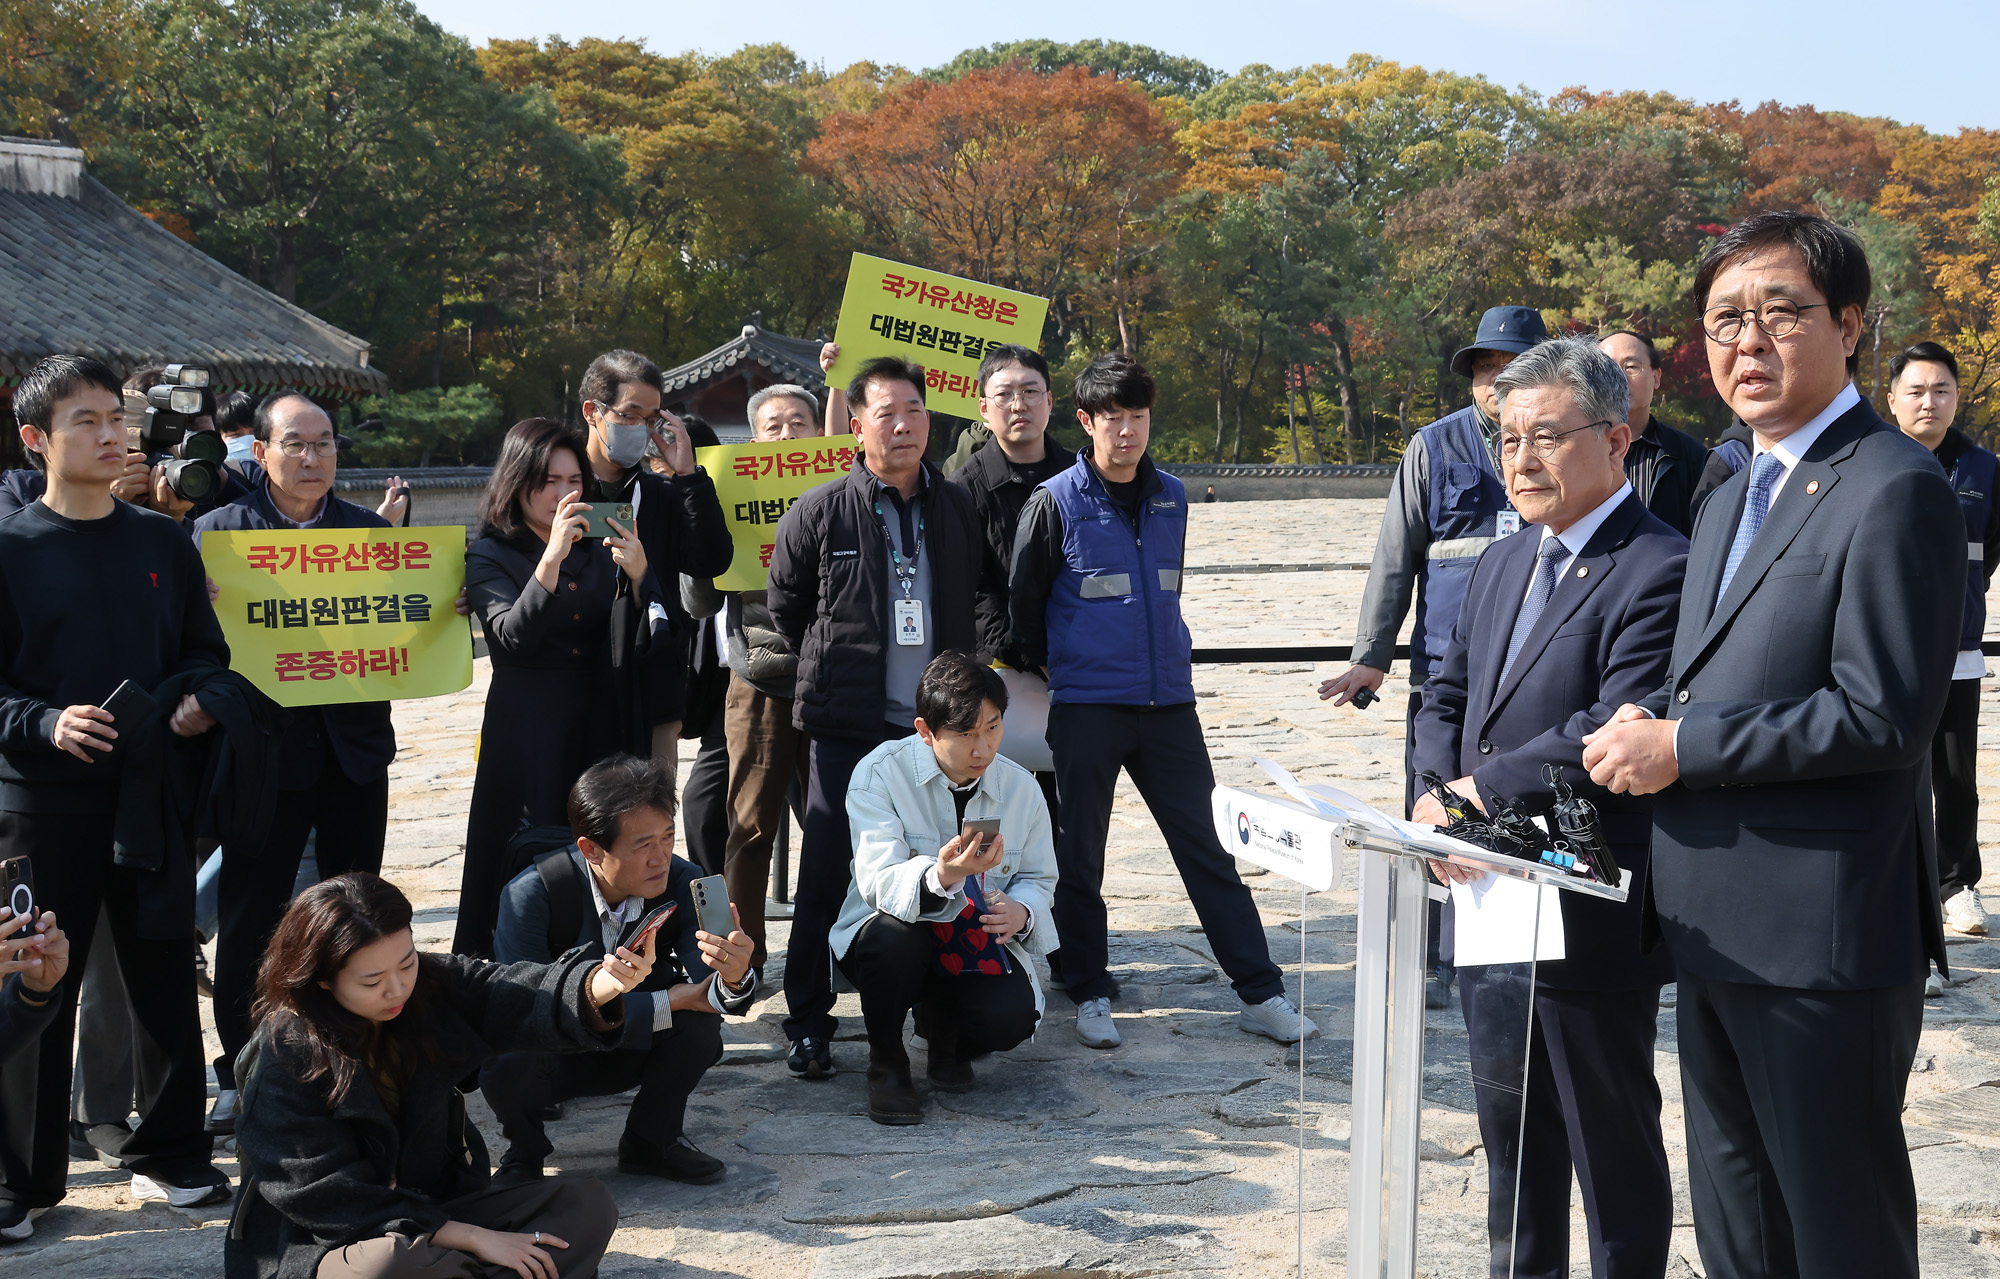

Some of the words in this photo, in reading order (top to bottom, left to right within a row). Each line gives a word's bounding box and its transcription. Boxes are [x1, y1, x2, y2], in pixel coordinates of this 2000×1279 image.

[881, 273, 1018, 326] 국가유산청은
[914, 365, 979, 398] 하라!
[734, 497, 799, 525] 대법
[247, 541, 432, 575] 국가유산청은
[247, 593, 432, 629] 대법원판결을
[274, 647, 409, 682] 존중하라!
